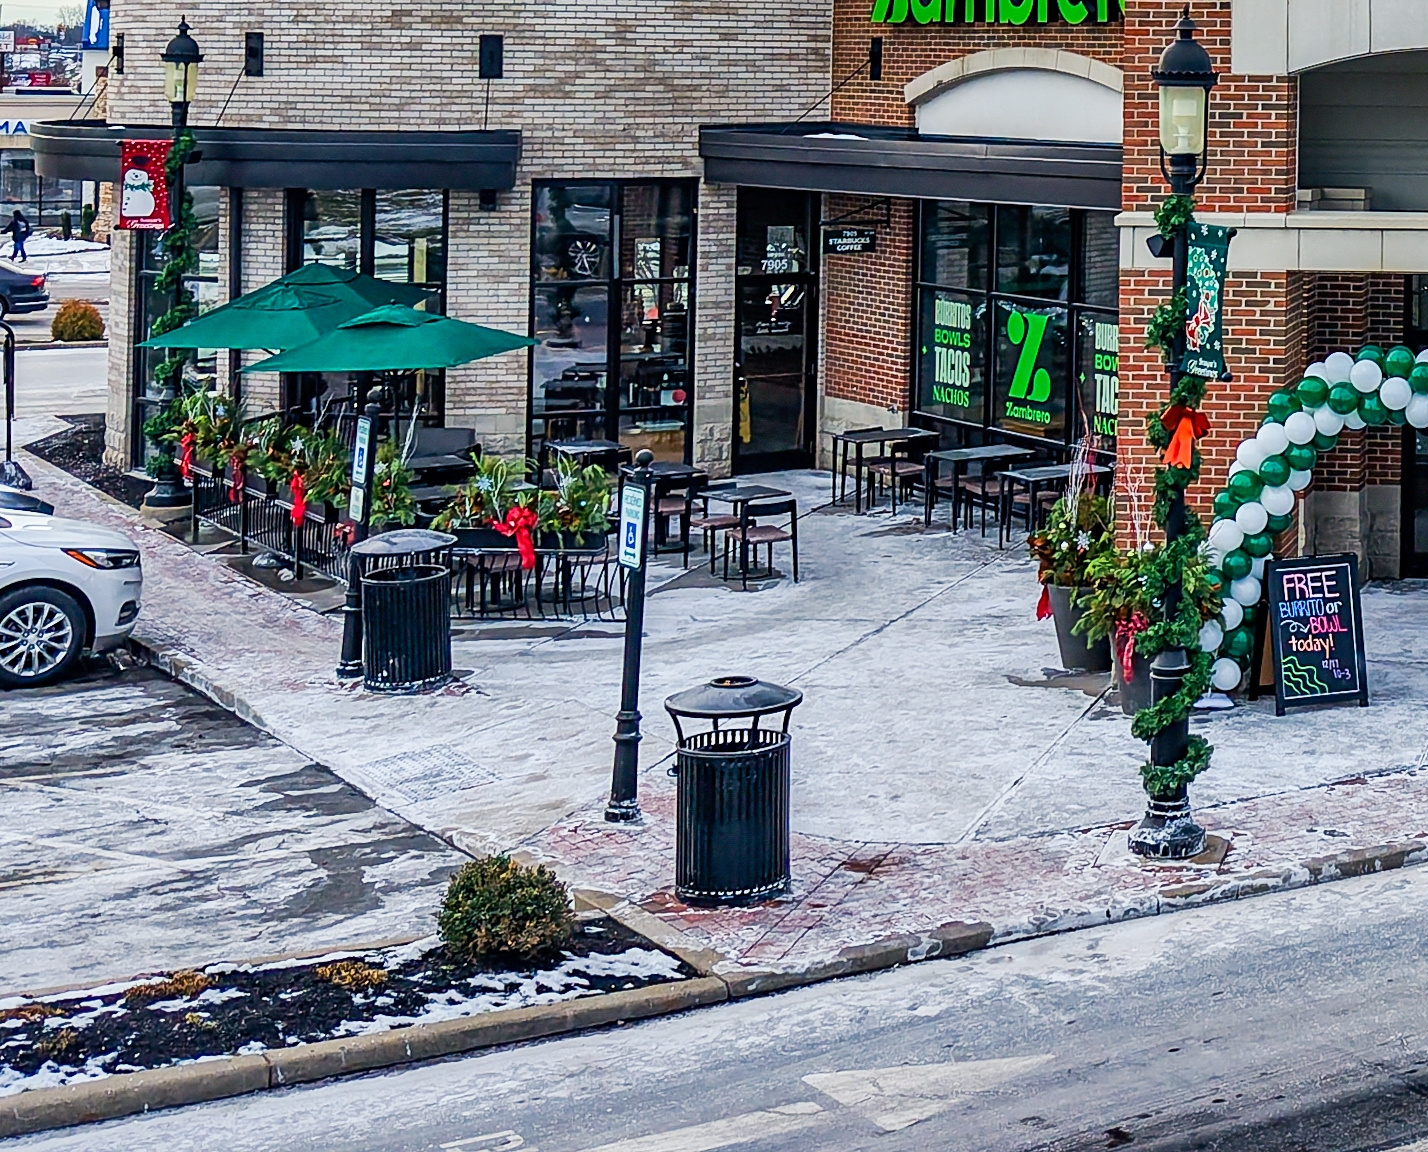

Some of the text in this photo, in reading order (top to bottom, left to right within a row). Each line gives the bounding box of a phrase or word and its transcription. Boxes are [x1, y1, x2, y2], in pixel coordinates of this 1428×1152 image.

[828, 237, 870, 245] STARBUCKS
[761, 259, 788, 270] 7905
[935, 299, 972, 330] BURRITOS
[934, 328, 971, 348] BOWLS
[1095, 322, 1119, 352] BURR
[934, 346, 971, 388] TACOS
[933, 385, 969, 408] NACHOS
[1094, 373, 1119, 416] TAC
[1005, 401, 1051, 424] Zambrero
[1093, 415, 1118, 436] NAC
[1282, 570, 1340, 601] FREE
[1279, 598, 1342, 618] BURRITO or
[1309, 614, 1348, 634] BOWL
[1288, 633, 1335, 659] today!
